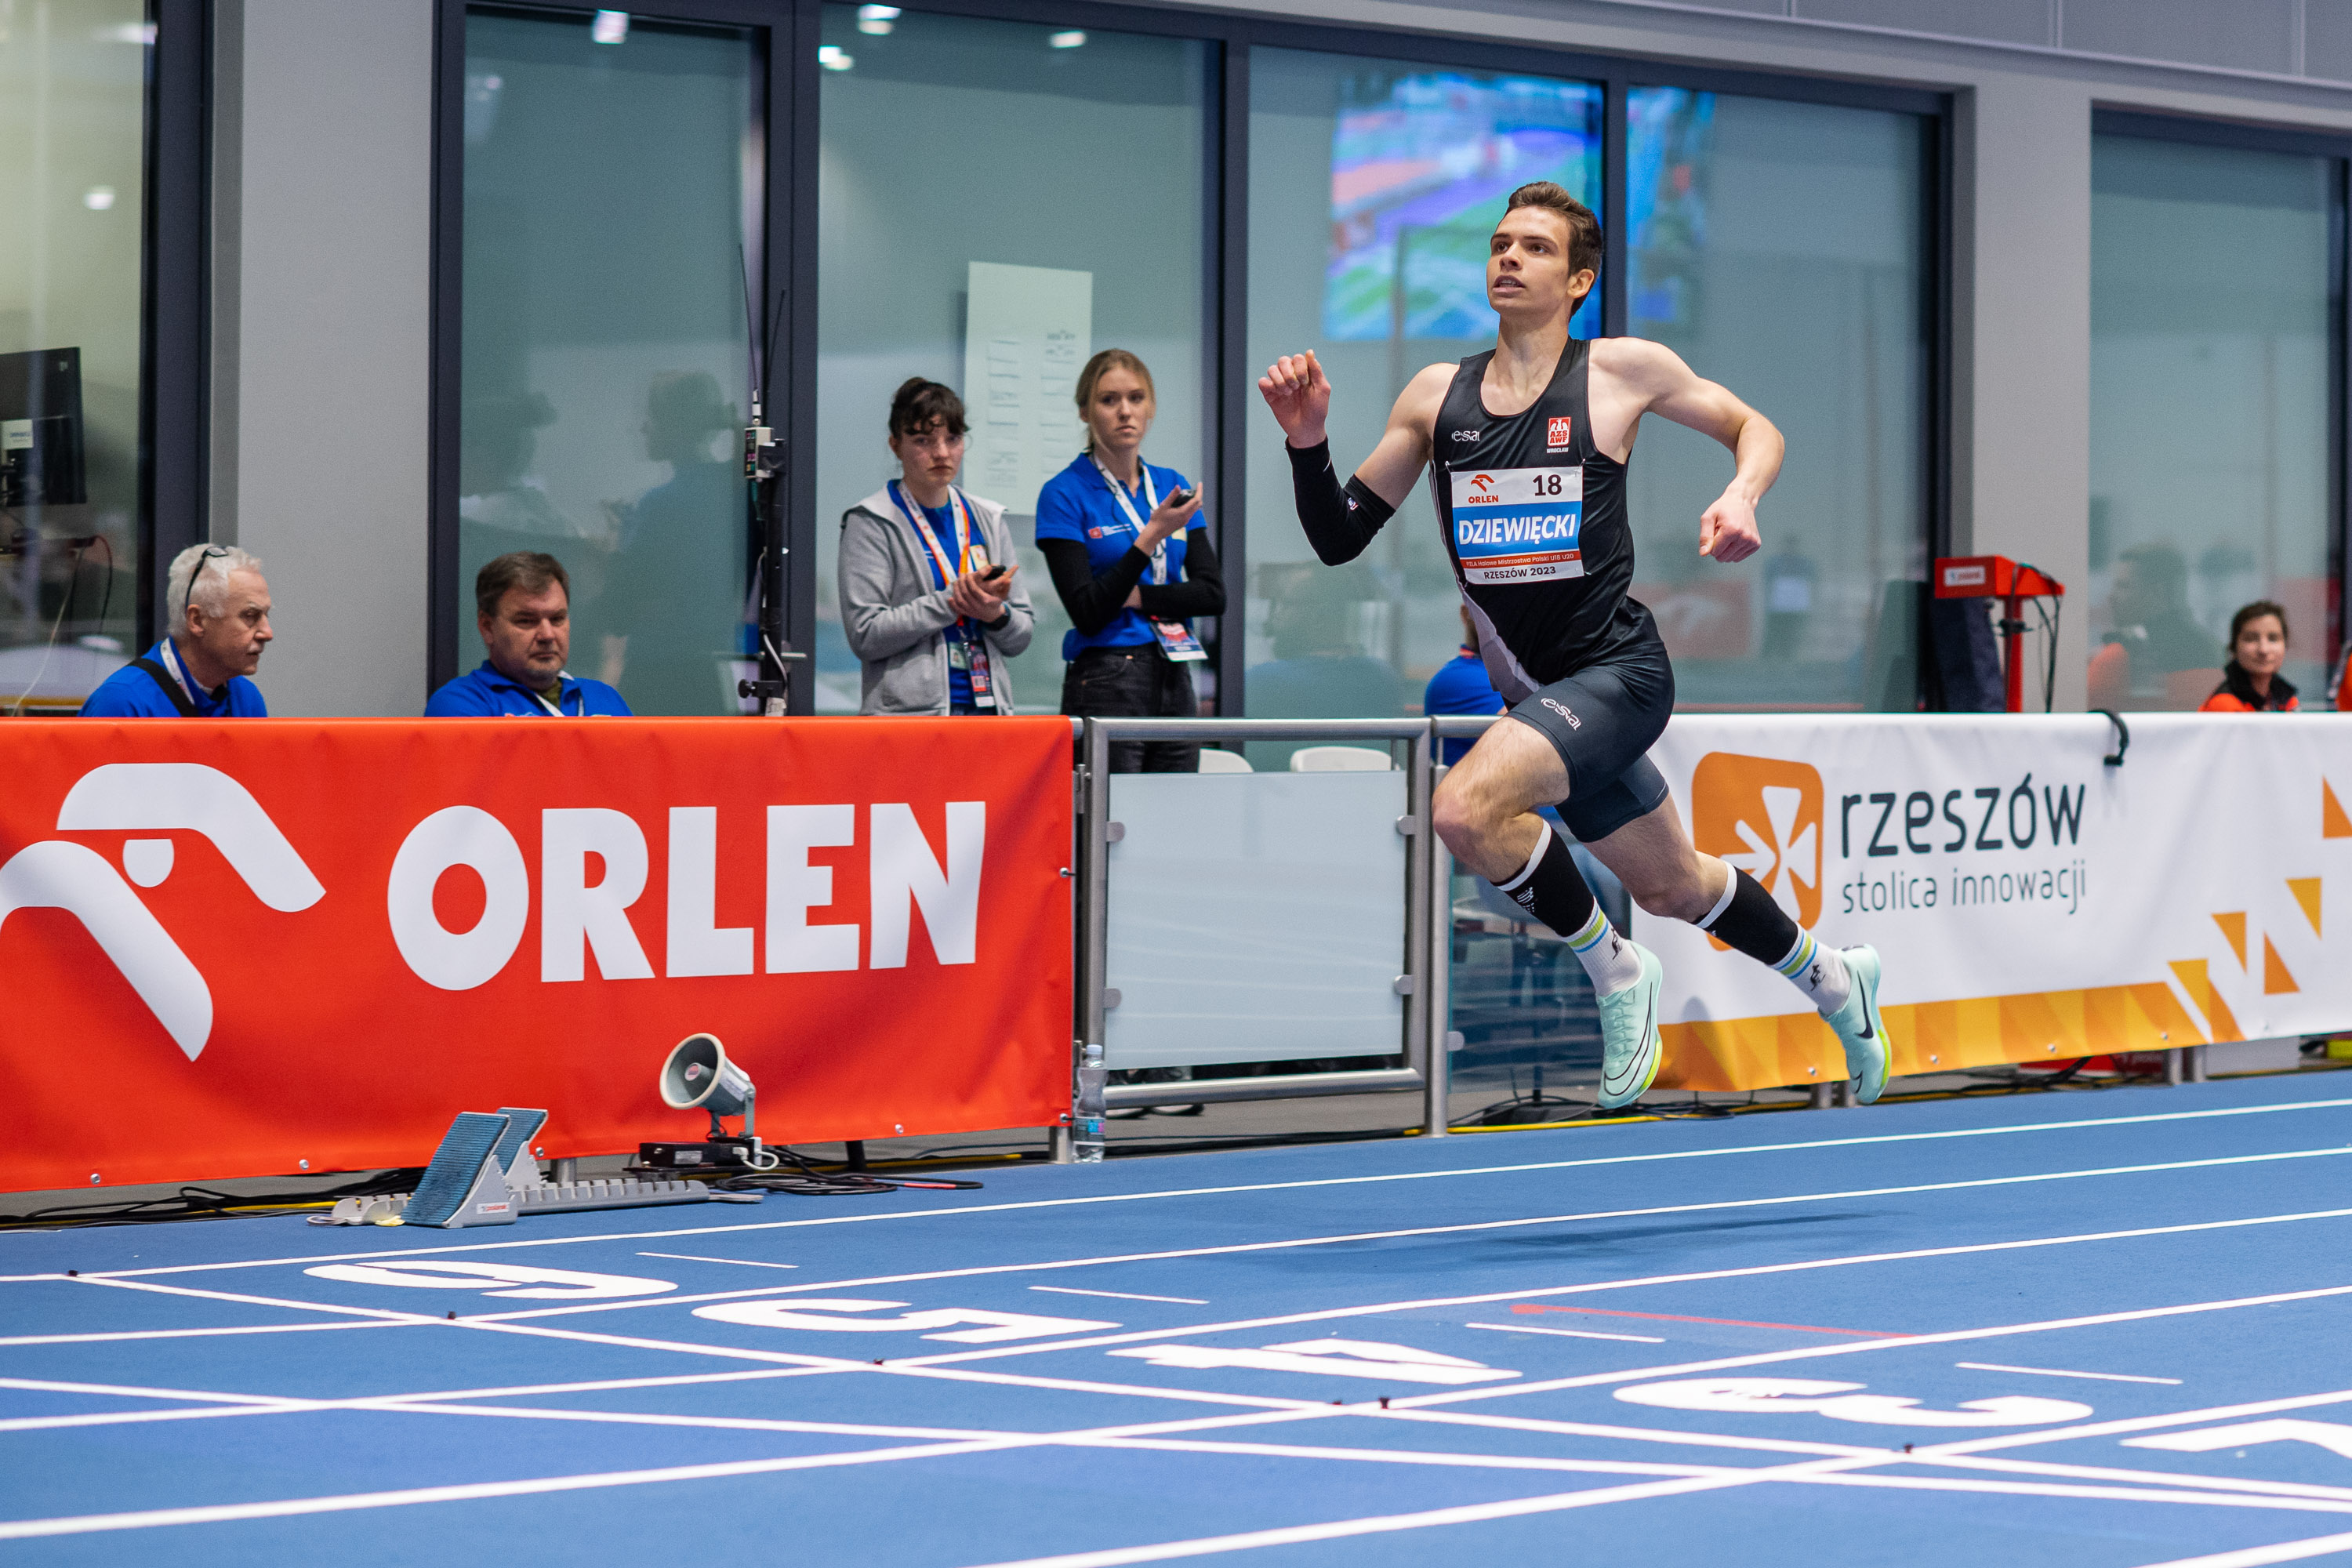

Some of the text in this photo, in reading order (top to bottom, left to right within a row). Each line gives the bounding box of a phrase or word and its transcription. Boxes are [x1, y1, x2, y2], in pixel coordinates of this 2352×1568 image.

[1468, 495, 1499, 504] ORLEN
[1532, 474, 1563, 496] 18
[1458, 514, 1576, 545] DZIEWIĘCKI
[1483, 566, 1556, 579] RZESZÓW 2023
[1497, 557, 1531, 565] Mistrzostwa
[1841, 772, 2086, 859] rzeszów
[387, 801, 986, 991] ORLEN
[1842, 860, 2087, 916] stolica innowacji
[691, 1298, 1123, 1344] 5
[1105, 1338, 1523, 1385] 4
[1613, 1377, 2093, 1427] 3
